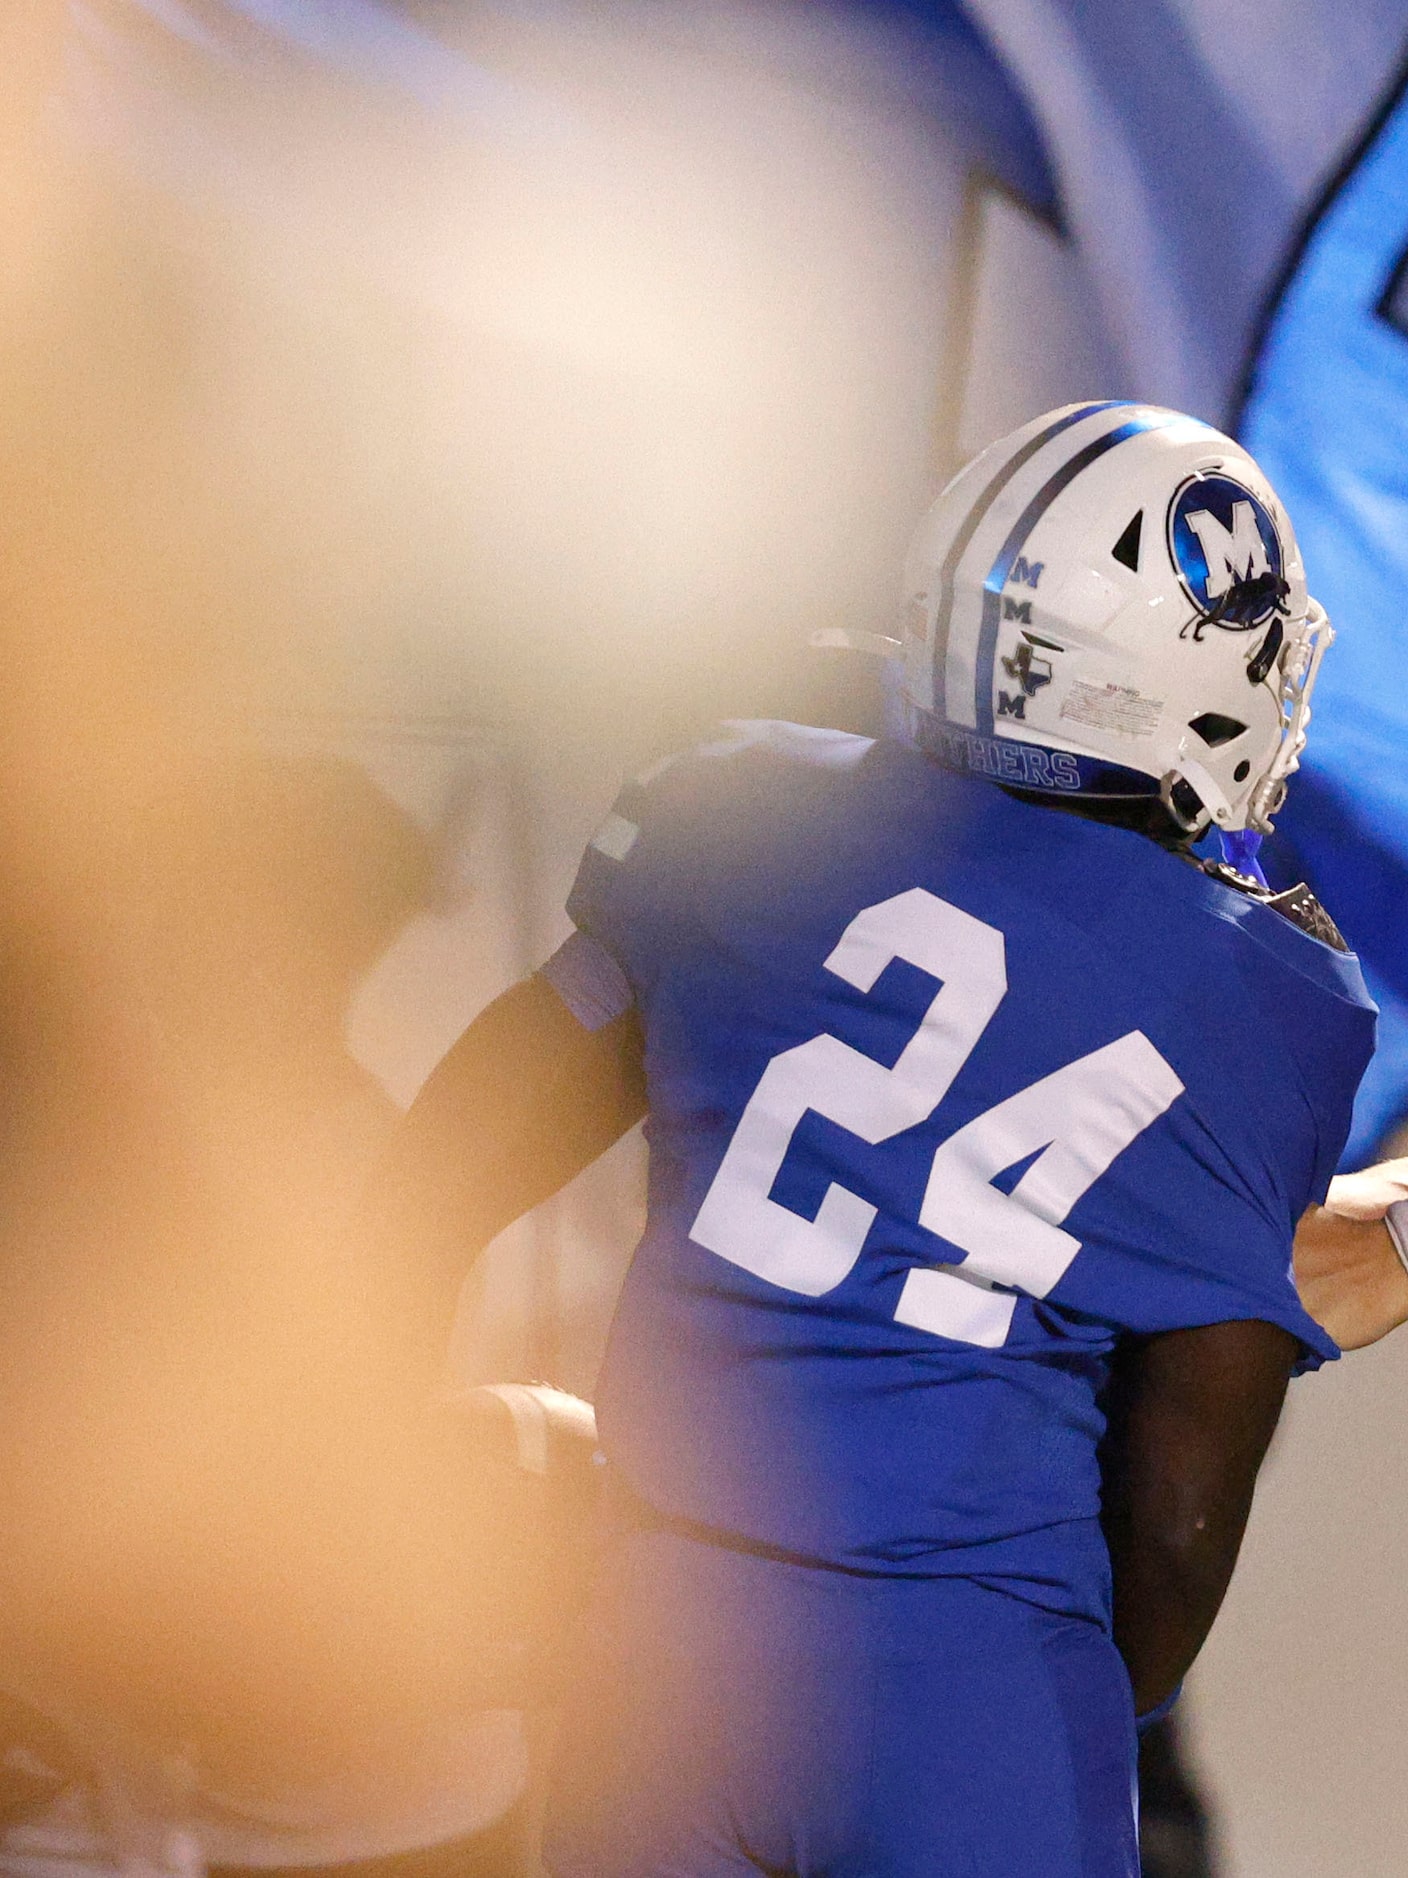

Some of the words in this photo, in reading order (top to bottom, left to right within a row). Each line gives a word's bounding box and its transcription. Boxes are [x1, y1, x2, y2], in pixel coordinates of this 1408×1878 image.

[1184, 500, 1272, 600] M
[1009, 556, 1045, 589] M
[1003, 596, 1033, 625] M
[997, 690, 1027, 720] M
[689, 887, 1186, 1349] 24
